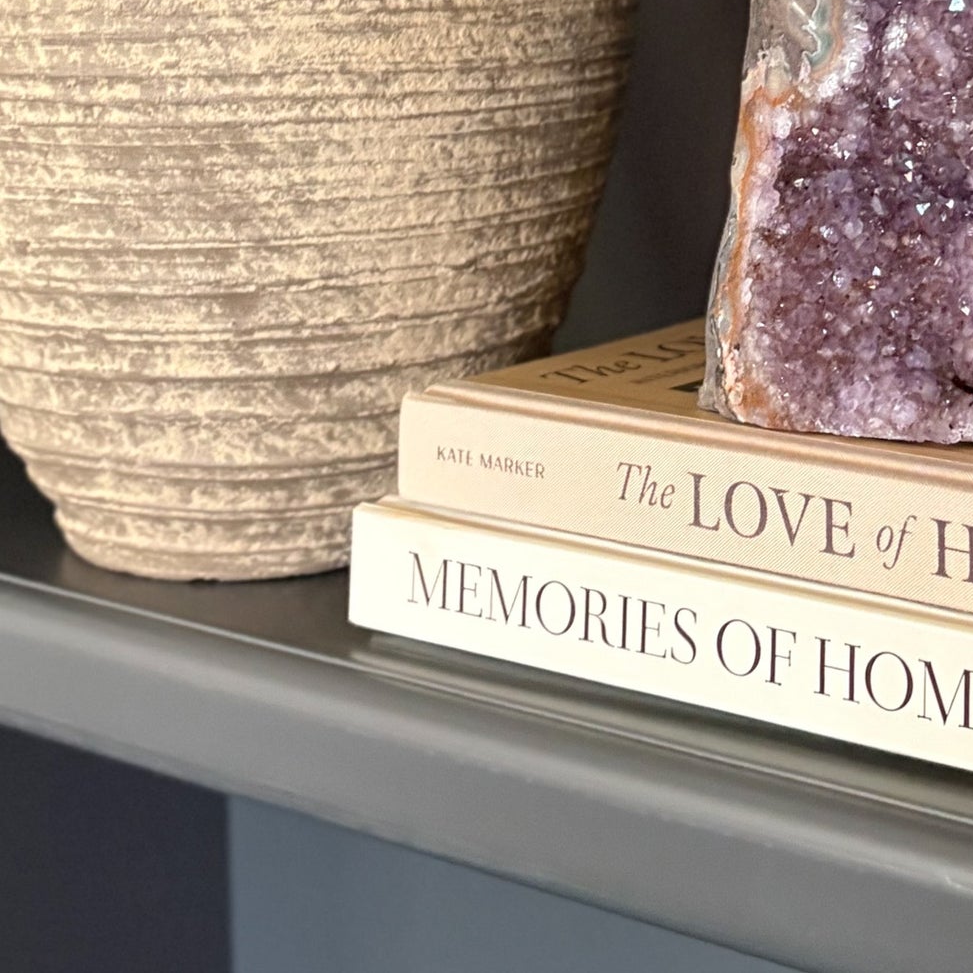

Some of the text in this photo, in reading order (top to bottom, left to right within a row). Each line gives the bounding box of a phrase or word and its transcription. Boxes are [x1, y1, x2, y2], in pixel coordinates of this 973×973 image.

[540, 355, 641, 384] The
[436, 445, 546, 480] KATE MARKER
[616, 462, 676, 509] The
[688, 472, 857, 559] LOVE
[876, 515, 917, 570] of
[407, 551, 698, 665] MEMORIES
[716, 619, 797, 687] OF
